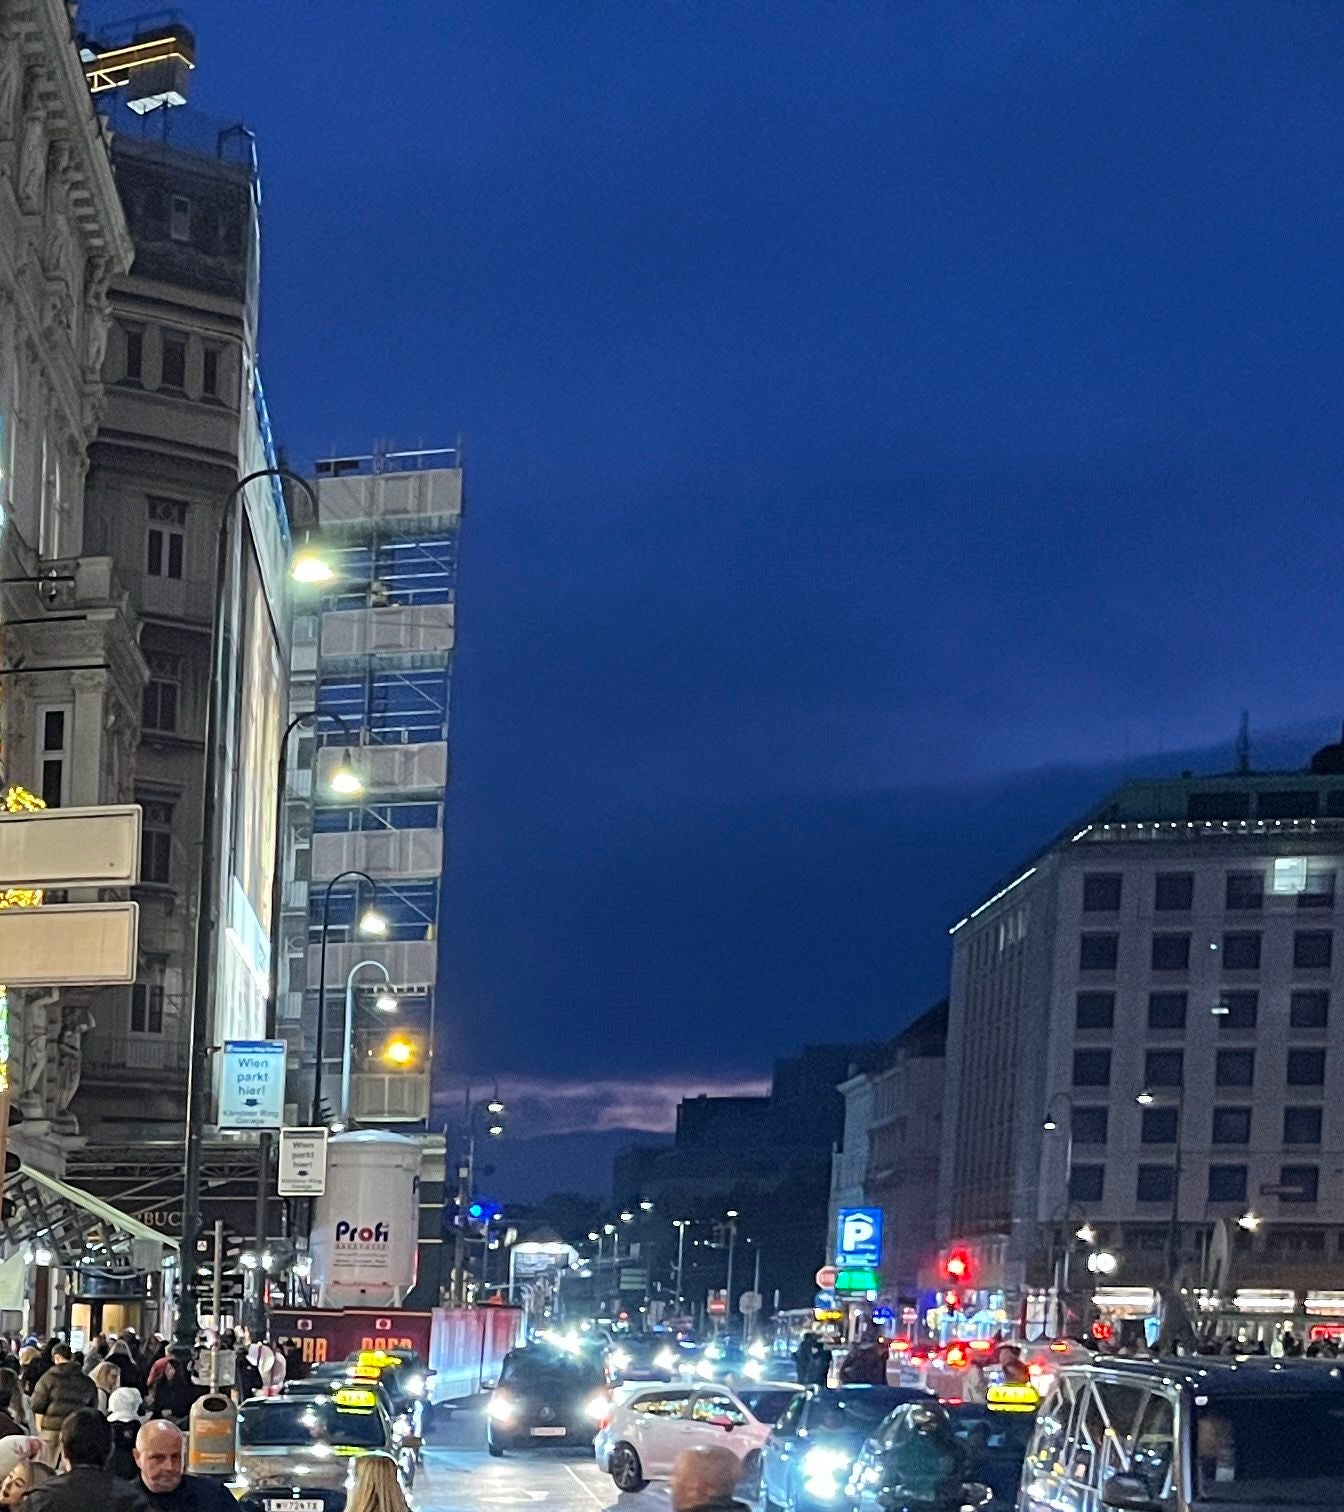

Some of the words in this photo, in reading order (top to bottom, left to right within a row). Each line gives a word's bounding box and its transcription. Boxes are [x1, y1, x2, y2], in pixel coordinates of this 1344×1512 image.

[238, 1057, 269, 1068] Wien
[237, 1071, 269, 1083] parkt
[238, 1085, 266, 1096] hier!
[335, 1221, 390, 1242] Profi
[842, 1220, 873, 1252] P
